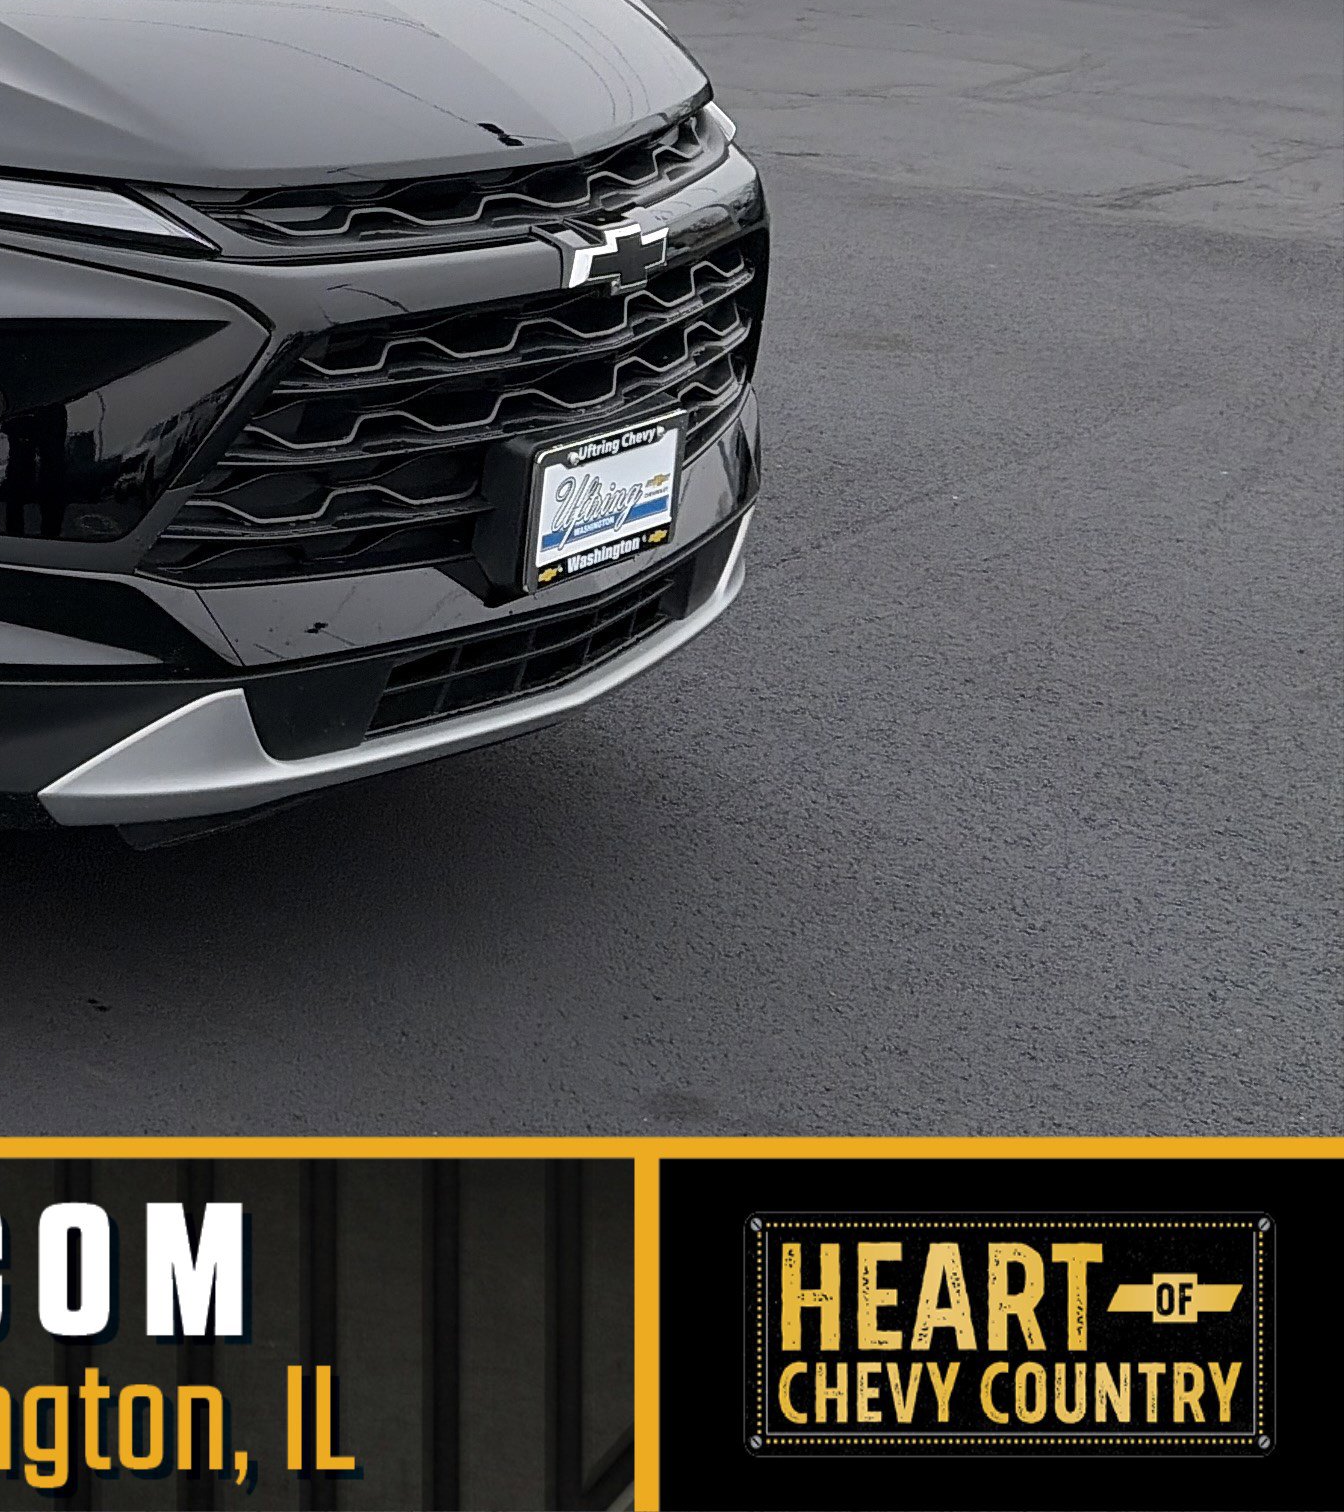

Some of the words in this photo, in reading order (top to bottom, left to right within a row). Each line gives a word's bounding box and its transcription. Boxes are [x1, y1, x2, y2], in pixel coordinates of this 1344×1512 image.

[578, 439, 620, 461] Uftring
[621, 428, 656, 448] Chevy
[551, 474, 643, 550] Uftring
[567, 537, 640, 574] Washington
